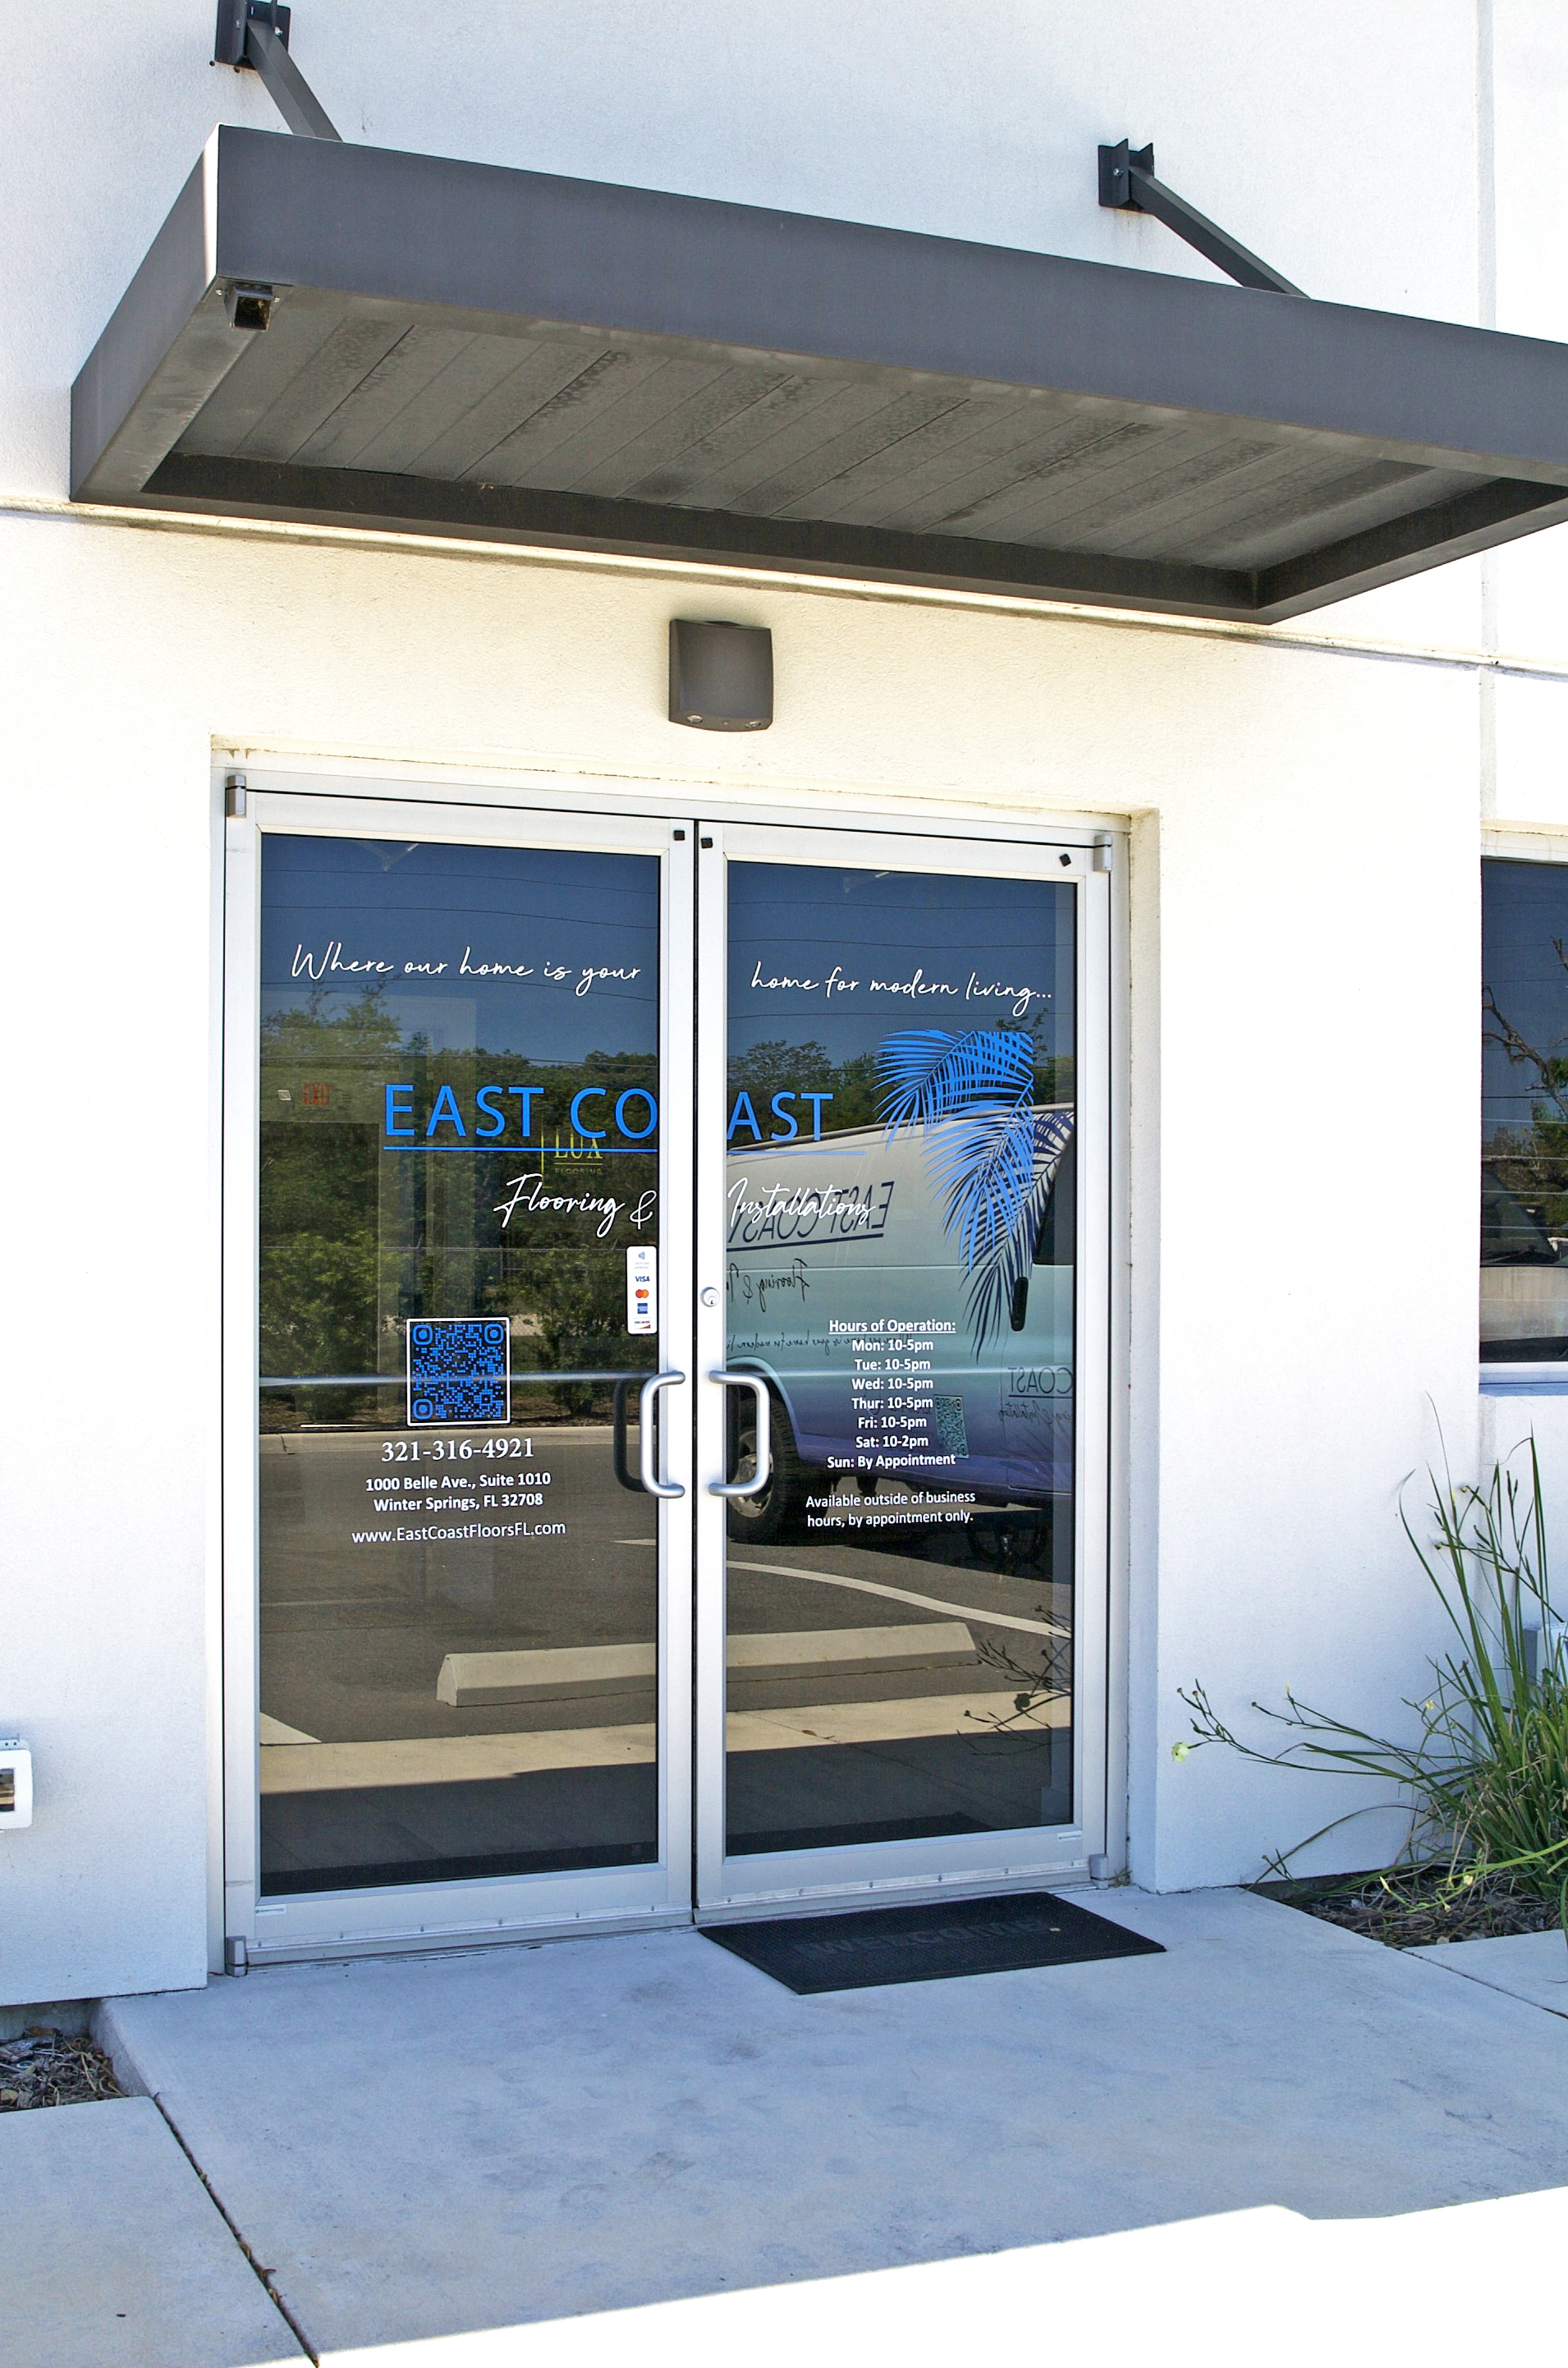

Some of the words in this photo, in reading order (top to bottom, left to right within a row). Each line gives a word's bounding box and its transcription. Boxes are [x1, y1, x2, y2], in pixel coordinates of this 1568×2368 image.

[292, 942, 393, 979] Where
[405, 962, 447, 974] our
[460, 947, 534, 975] home
[544, 962, 571, 980] is
[576, 968, 640, 996] your
[752, 961, 818, 989] home
[825, 966, 859, 998] for
[870, 969, 958, 998] modern
[966, 972, 1051, 1016] living...
[302, 1081, 332, 1105] EXIT
[386, 1085, 543, 1136] EAST
[493, 1173, 625, 1237] Flooring
[630, 1191, 656, 1229] &
[727, 1177, 875, 1228] Installations
[830, 1320, 866, 1332] Hours
[871, 1319, 884, 1331] of
[887, 1319, 956, 1333] Operation:
[852, 1340, 884, 1351] Mon:
[888, 1339, 933, 1352] 10-5pm
[855, 1360, 881, 1370] Tue:
[885, 1359, 931, 1372] 10-5pm
[852, 1378, 883, 1389] Wed:
[888, 1378, 933, 1391] 10-5pm
[852, 1397, 883, 1409] Thur:
[888, 1397, 933, 1411] 10-5pm
[859, 1416, 877, 1428] Fri:
[882, 1416, 926, 1430] 10-5pm
[382, 1438, 533, 1462] 321-316-4921
[856, 1437, 878, 1448] Sat:
[883, 1435, 928, 1448] 10-2pm
[828, 1457, 854, 1468] Sun:
[858, 1456, 873, 1469] By
[876, 1454, 956, 1469] Appointment
[366, 1478, 400, 1490] 1000
[405, 1476, 438, 1489] Belle
[441, 1476, 475, 1489] Ave.,
[480, 1474, 514, 1486] Suite
[518, 1473, 550, 1485] 1010
[374, 1498, 422, 1511] Winter
[426, 1496, 479, 1512] Springs,
[484, 1495, 498, 1507] FL
[502, 1494, 543, 1506] 32708
[806, 1494, 860, 1507] Available
[864, 1493, 907, 1505] outside
[911, 1492, 924, 1503] of
[927, 1491, 975, 1503] business
[808, 1515, 845, 1527] hours,
[849, 1513, 863, 1527] by
[866, 1512, 942, 1526] appointment
[945, 1509, 974, 1524] only.
[352, 1522, 565, 1543] www.EastCoastFloorsFL.com
